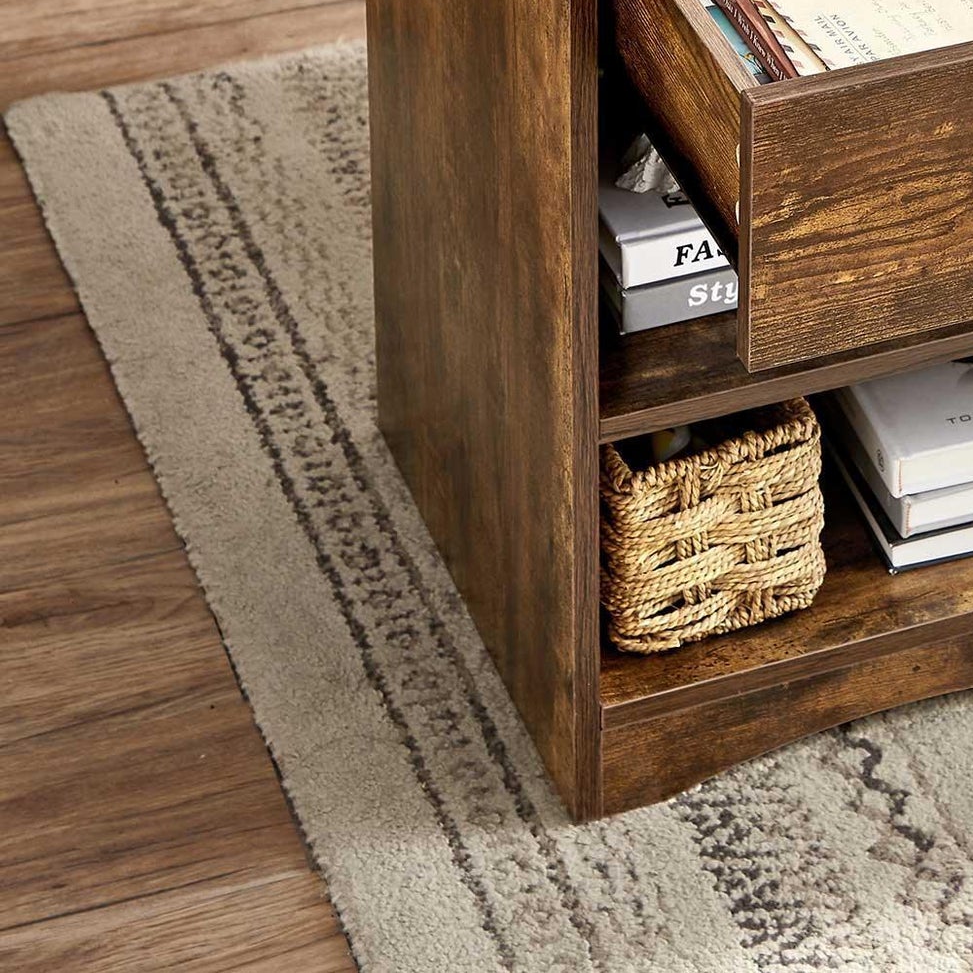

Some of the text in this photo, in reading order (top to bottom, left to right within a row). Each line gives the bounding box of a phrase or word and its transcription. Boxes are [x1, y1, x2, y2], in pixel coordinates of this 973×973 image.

[814, 15, 837, 37] MAIL
[830, 14, 880, 61] PAR AVION
[835, 38, 854, 54] AIR
[674, 240, 724, 267] FA
